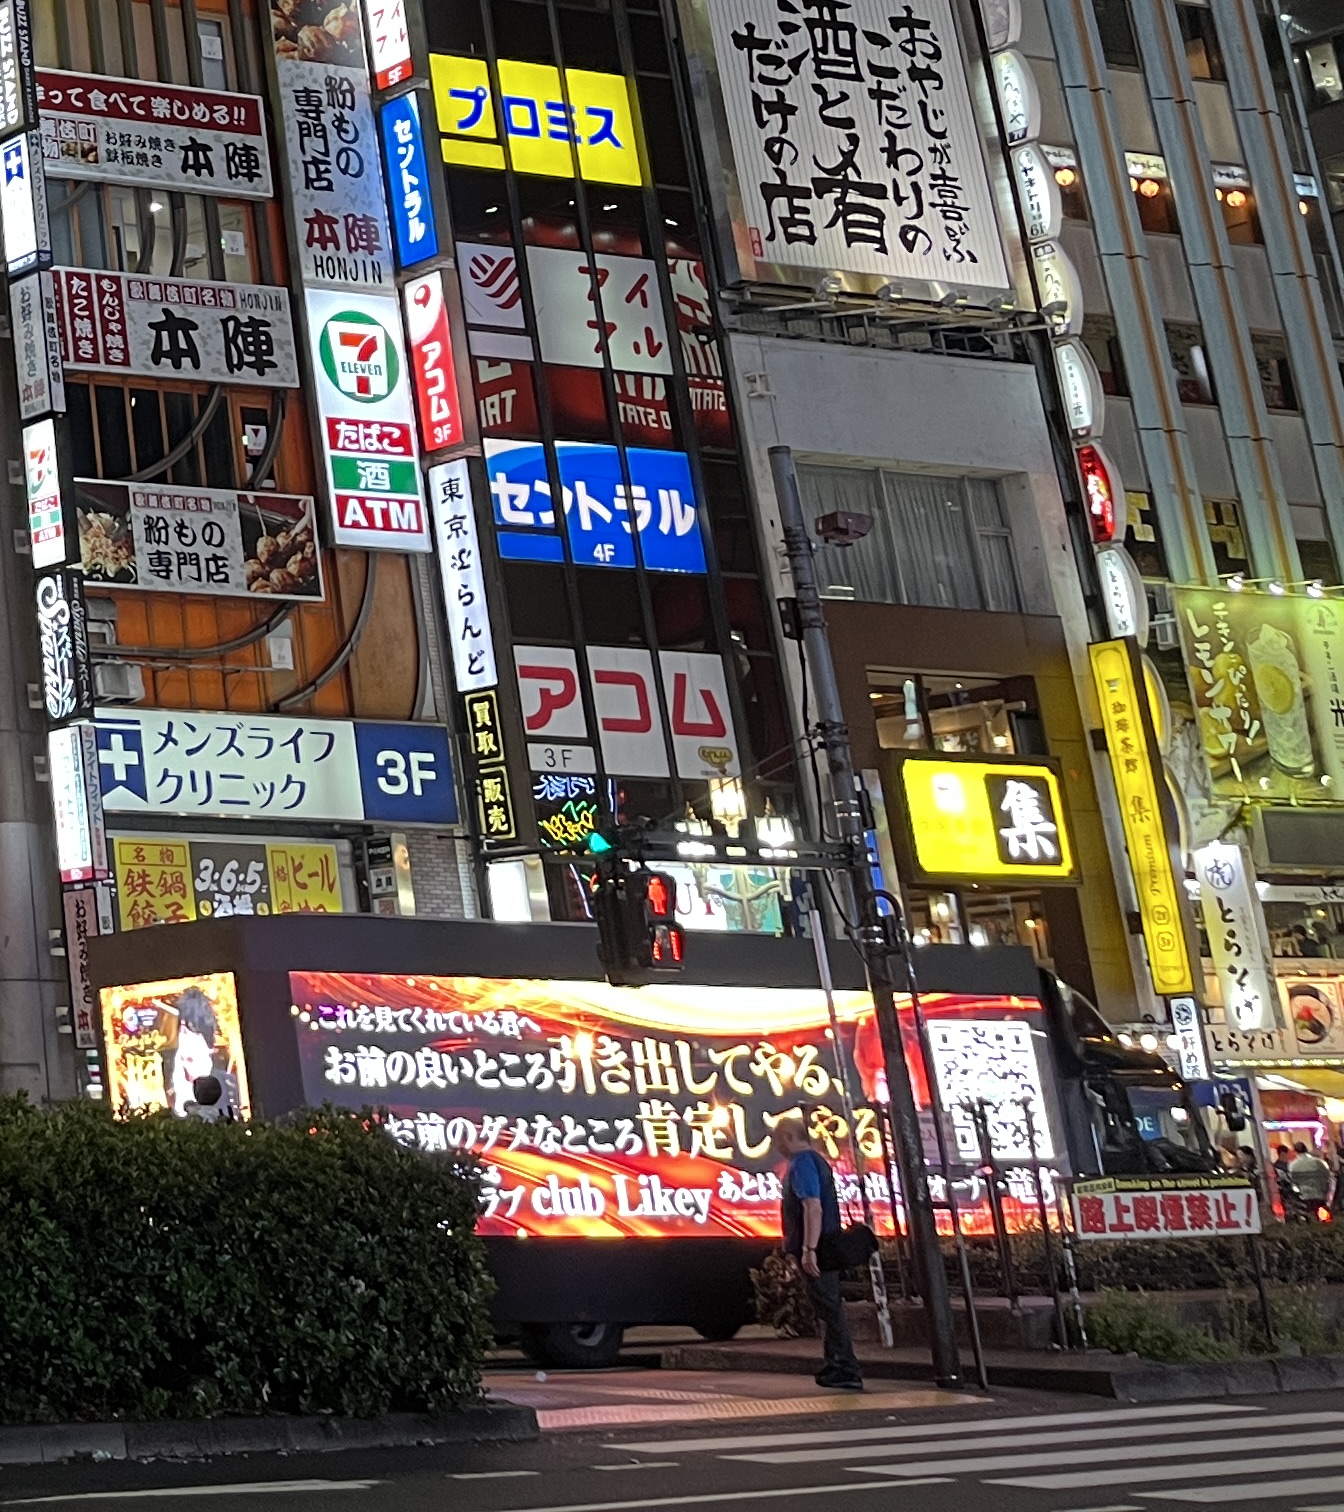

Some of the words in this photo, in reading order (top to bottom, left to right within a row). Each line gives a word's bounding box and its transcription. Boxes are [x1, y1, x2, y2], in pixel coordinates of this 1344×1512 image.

[18, 29, 32, 67] STAND
[387, 67, 404, 87] 5F
[292, 86, 335, 193] 専門店
[324, 74, 364, 180] 粉もの
[448, 85, 625, 151] プロミス
[730, 20, 818, 247] だけの店
[887, 4, 979, 266] おやじが喜ぶ
[105, 130, 176, 153] お好み焼き
[105, 147, 163, 169] 鉄板焼き
[179, 135, 263, 183] 本陣
[861, 30, 933, 257] こだわりの
[393, 118, 427, 244] セントラル
[304, 207, 383, 257] 本陣
[312, 253, 385, 285] HONJIN
[70, 276, 95, 359] たこ焼き
[128, 279, 236, 310] 歌舞伎町名物
[238, 291, 283, 313] HONJIN
[100, 278, 126, 364] もんじゃ焼き
[147, 307, 279, 378] 本陣
[420, 340, 451, 423] アコム
[335, 420, 406, 454] たばこ
[433, 423, 453, 444] 3F
[357, 460, 391, 491] 酒
[342, 497, 417, 532] ATM
[490, 470, 698, 538] セントラル
[143, 514, 226, 549] 粉もの
[592, 543, 616, 562] 4F
[147, 550, 231, 585] 専門店
[518, 663, 728, 739] アコム
[1185, 607, 1243, 783] レモンサワー
[152, 719, 336, 764] メンズライフ
[472, 700, 498, 756] 買取
[375, 749, 438, 797] 3F
[543, 748, 574, 769] 3F
[155, 767, 307, 811] クリニック
[482, 776, 509, 834] 販売
[998, 778, 1059, 862] 集
[131, 844, 175, 865] 名物
[290, 853, 337, 894] ビール
[1143, 833, 1162, 896] Premium
[123, 867, 188, 898] 鉄鍋
[317, 1003, 543, 1040] これを見てくれている君へ
[531, 1174, 606, 1219] club
[611, 1174, 714, 1225] Likey
[1078, 1191, 1253, 1234] 路上喫煙禁止!
